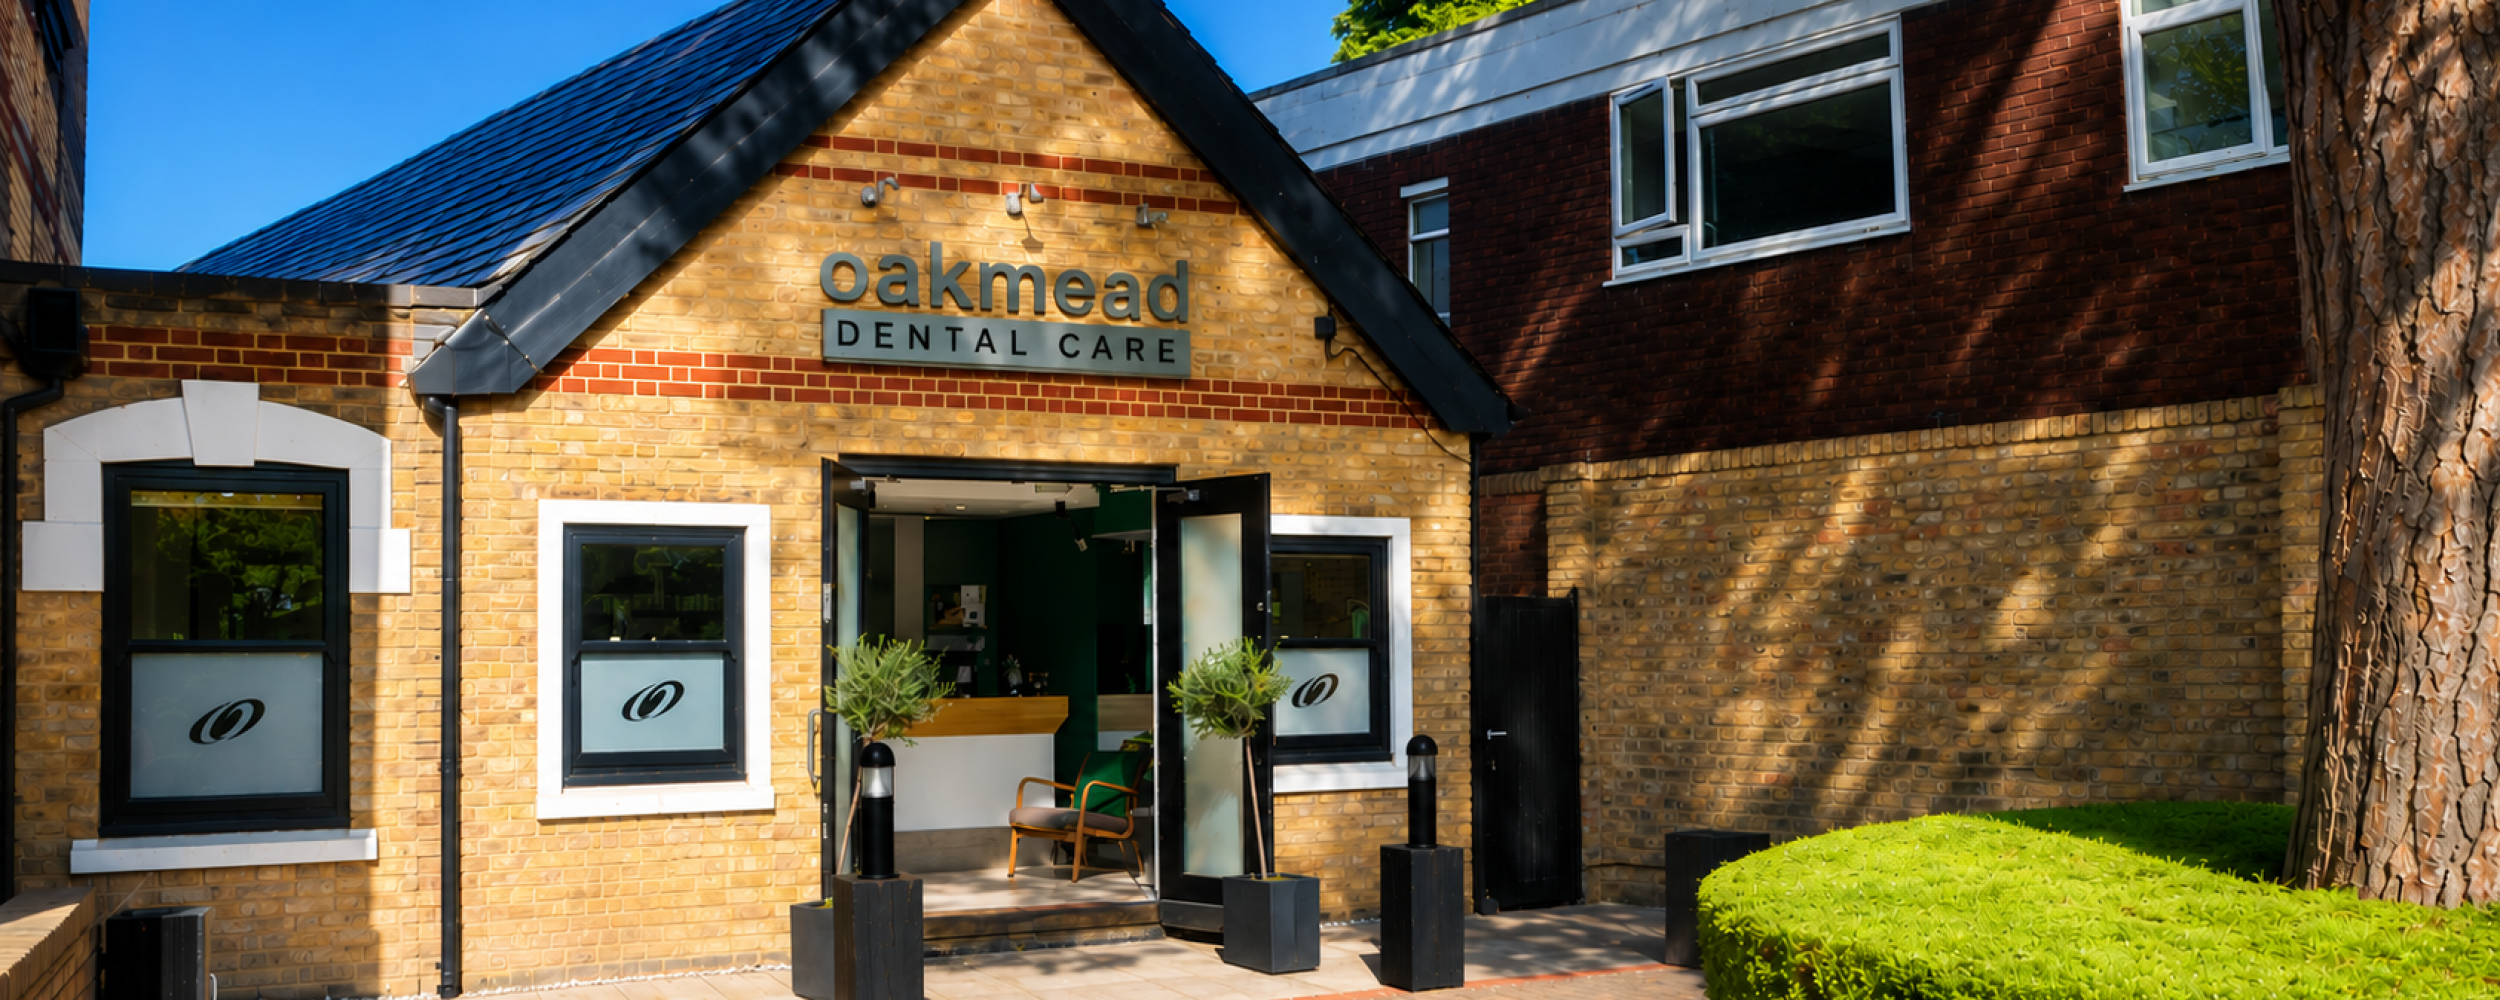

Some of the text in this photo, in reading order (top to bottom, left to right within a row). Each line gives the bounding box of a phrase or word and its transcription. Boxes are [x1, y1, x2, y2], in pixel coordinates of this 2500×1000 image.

[820, 241, 1189, 323] oakmead
[837, 320, 1176, 363] DENTAL CARE
